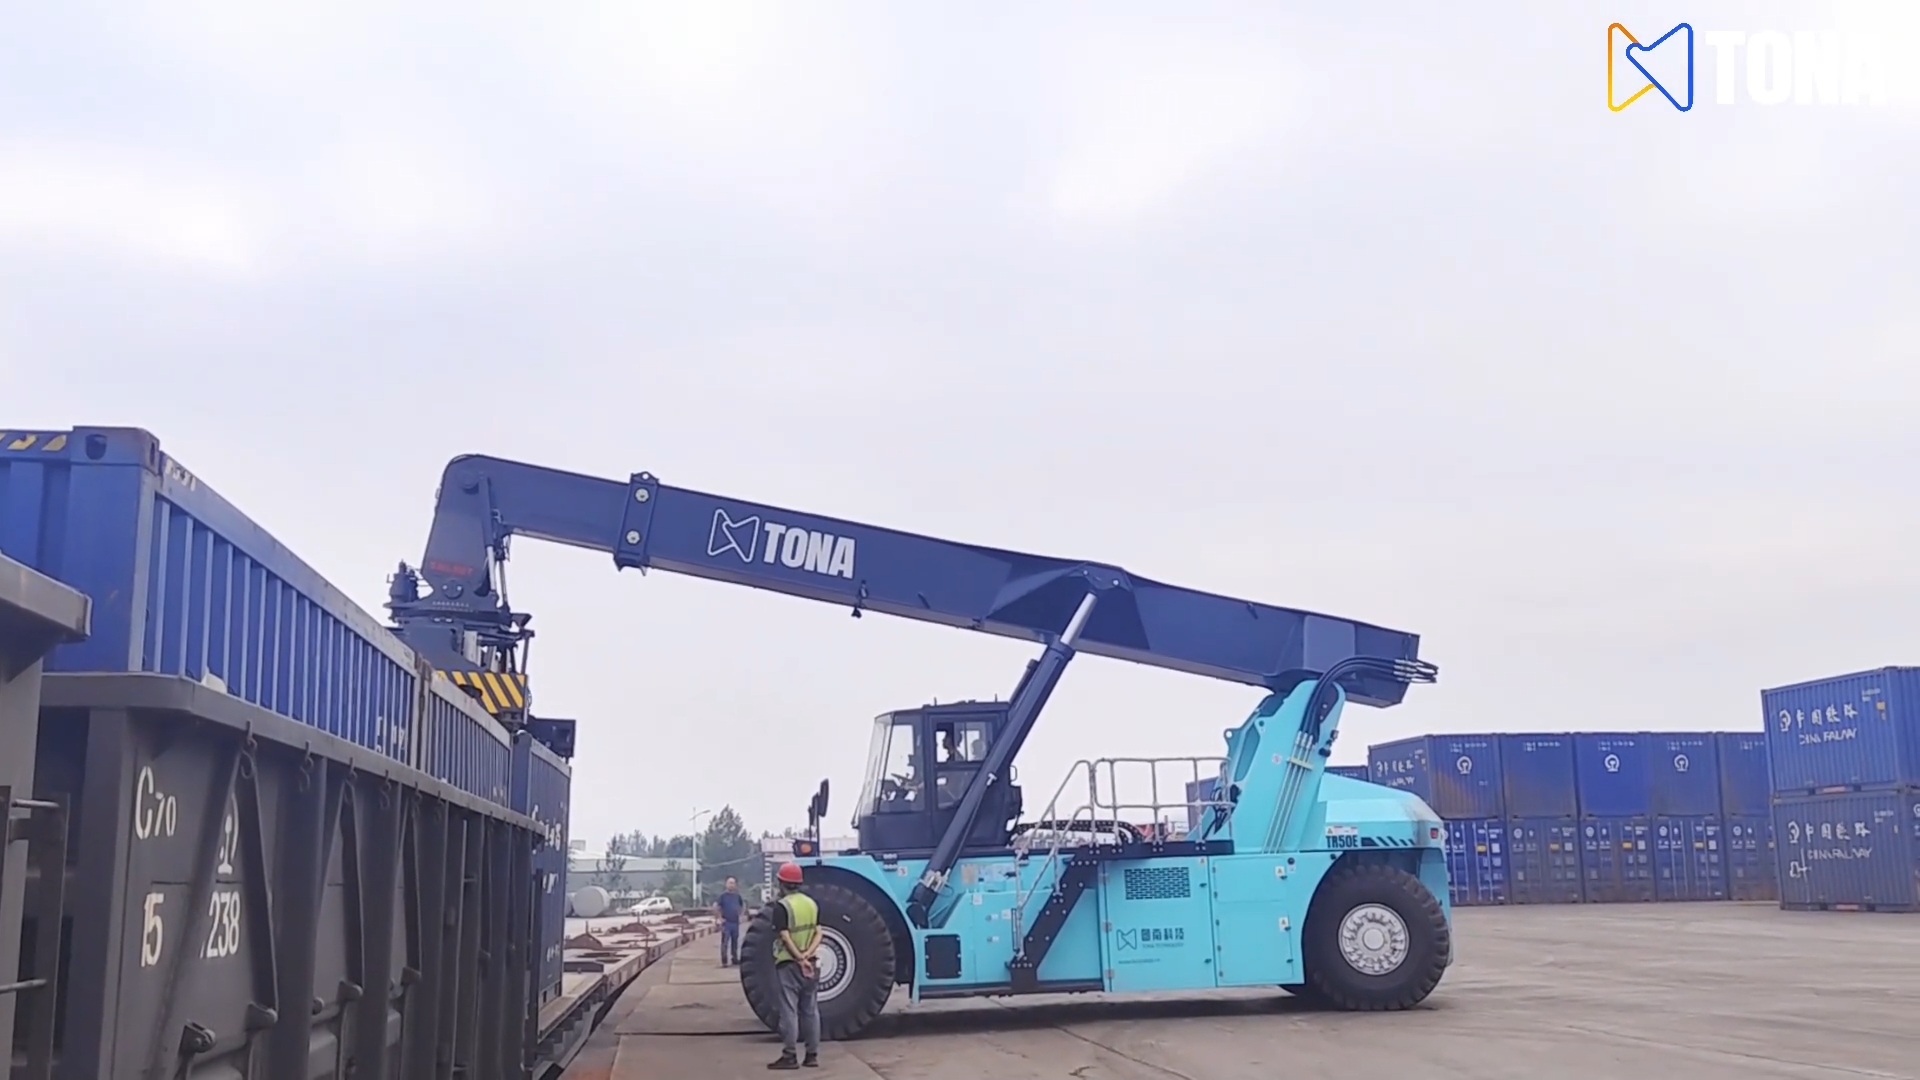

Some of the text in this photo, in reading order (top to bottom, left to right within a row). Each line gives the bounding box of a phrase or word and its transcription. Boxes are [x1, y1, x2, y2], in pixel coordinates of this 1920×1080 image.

[763, 522, 856, 580] TONA
[135, 766, 177, 840] C70
[1325, 835, 1359, 849] TR50E
[141, 891, 241, 967] 15 238
